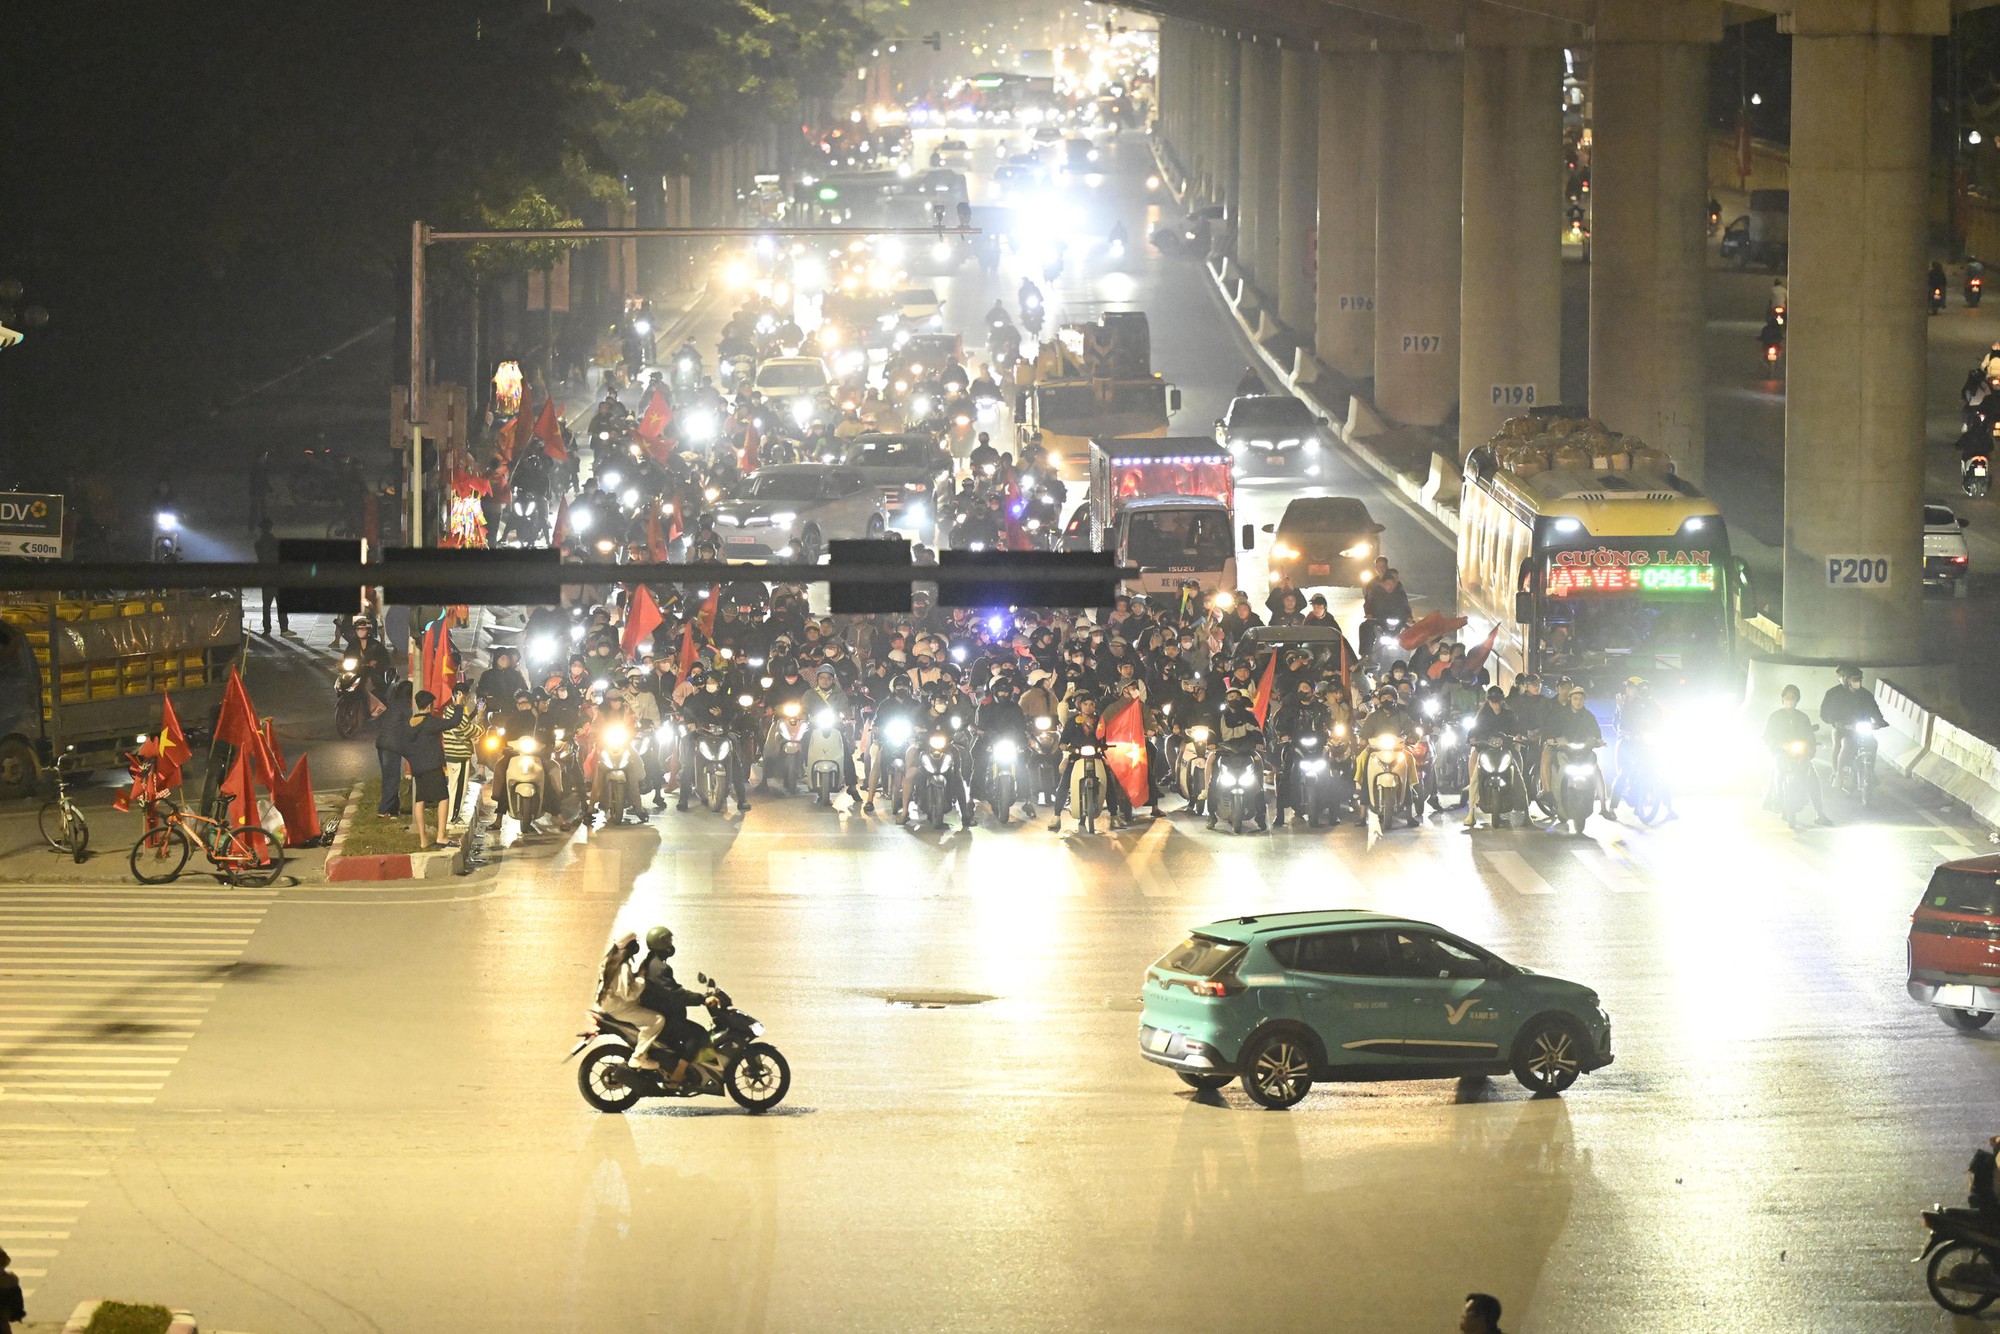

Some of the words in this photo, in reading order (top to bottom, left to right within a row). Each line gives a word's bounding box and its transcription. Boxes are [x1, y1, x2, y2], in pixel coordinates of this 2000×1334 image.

[1340, 297, 1374, 312] P196
[1403, 336, 1440, 352] P197
[1492, 386, 1535, 404] P198
[31, 543, 57, 554] 500m
[1556, 546, 1651, 567] CƯỜNG
[1657, 550, 1710, 567] LAN
[1829, 558, 1888, 583] P200
[1161, 578, 1170, 587] XE
